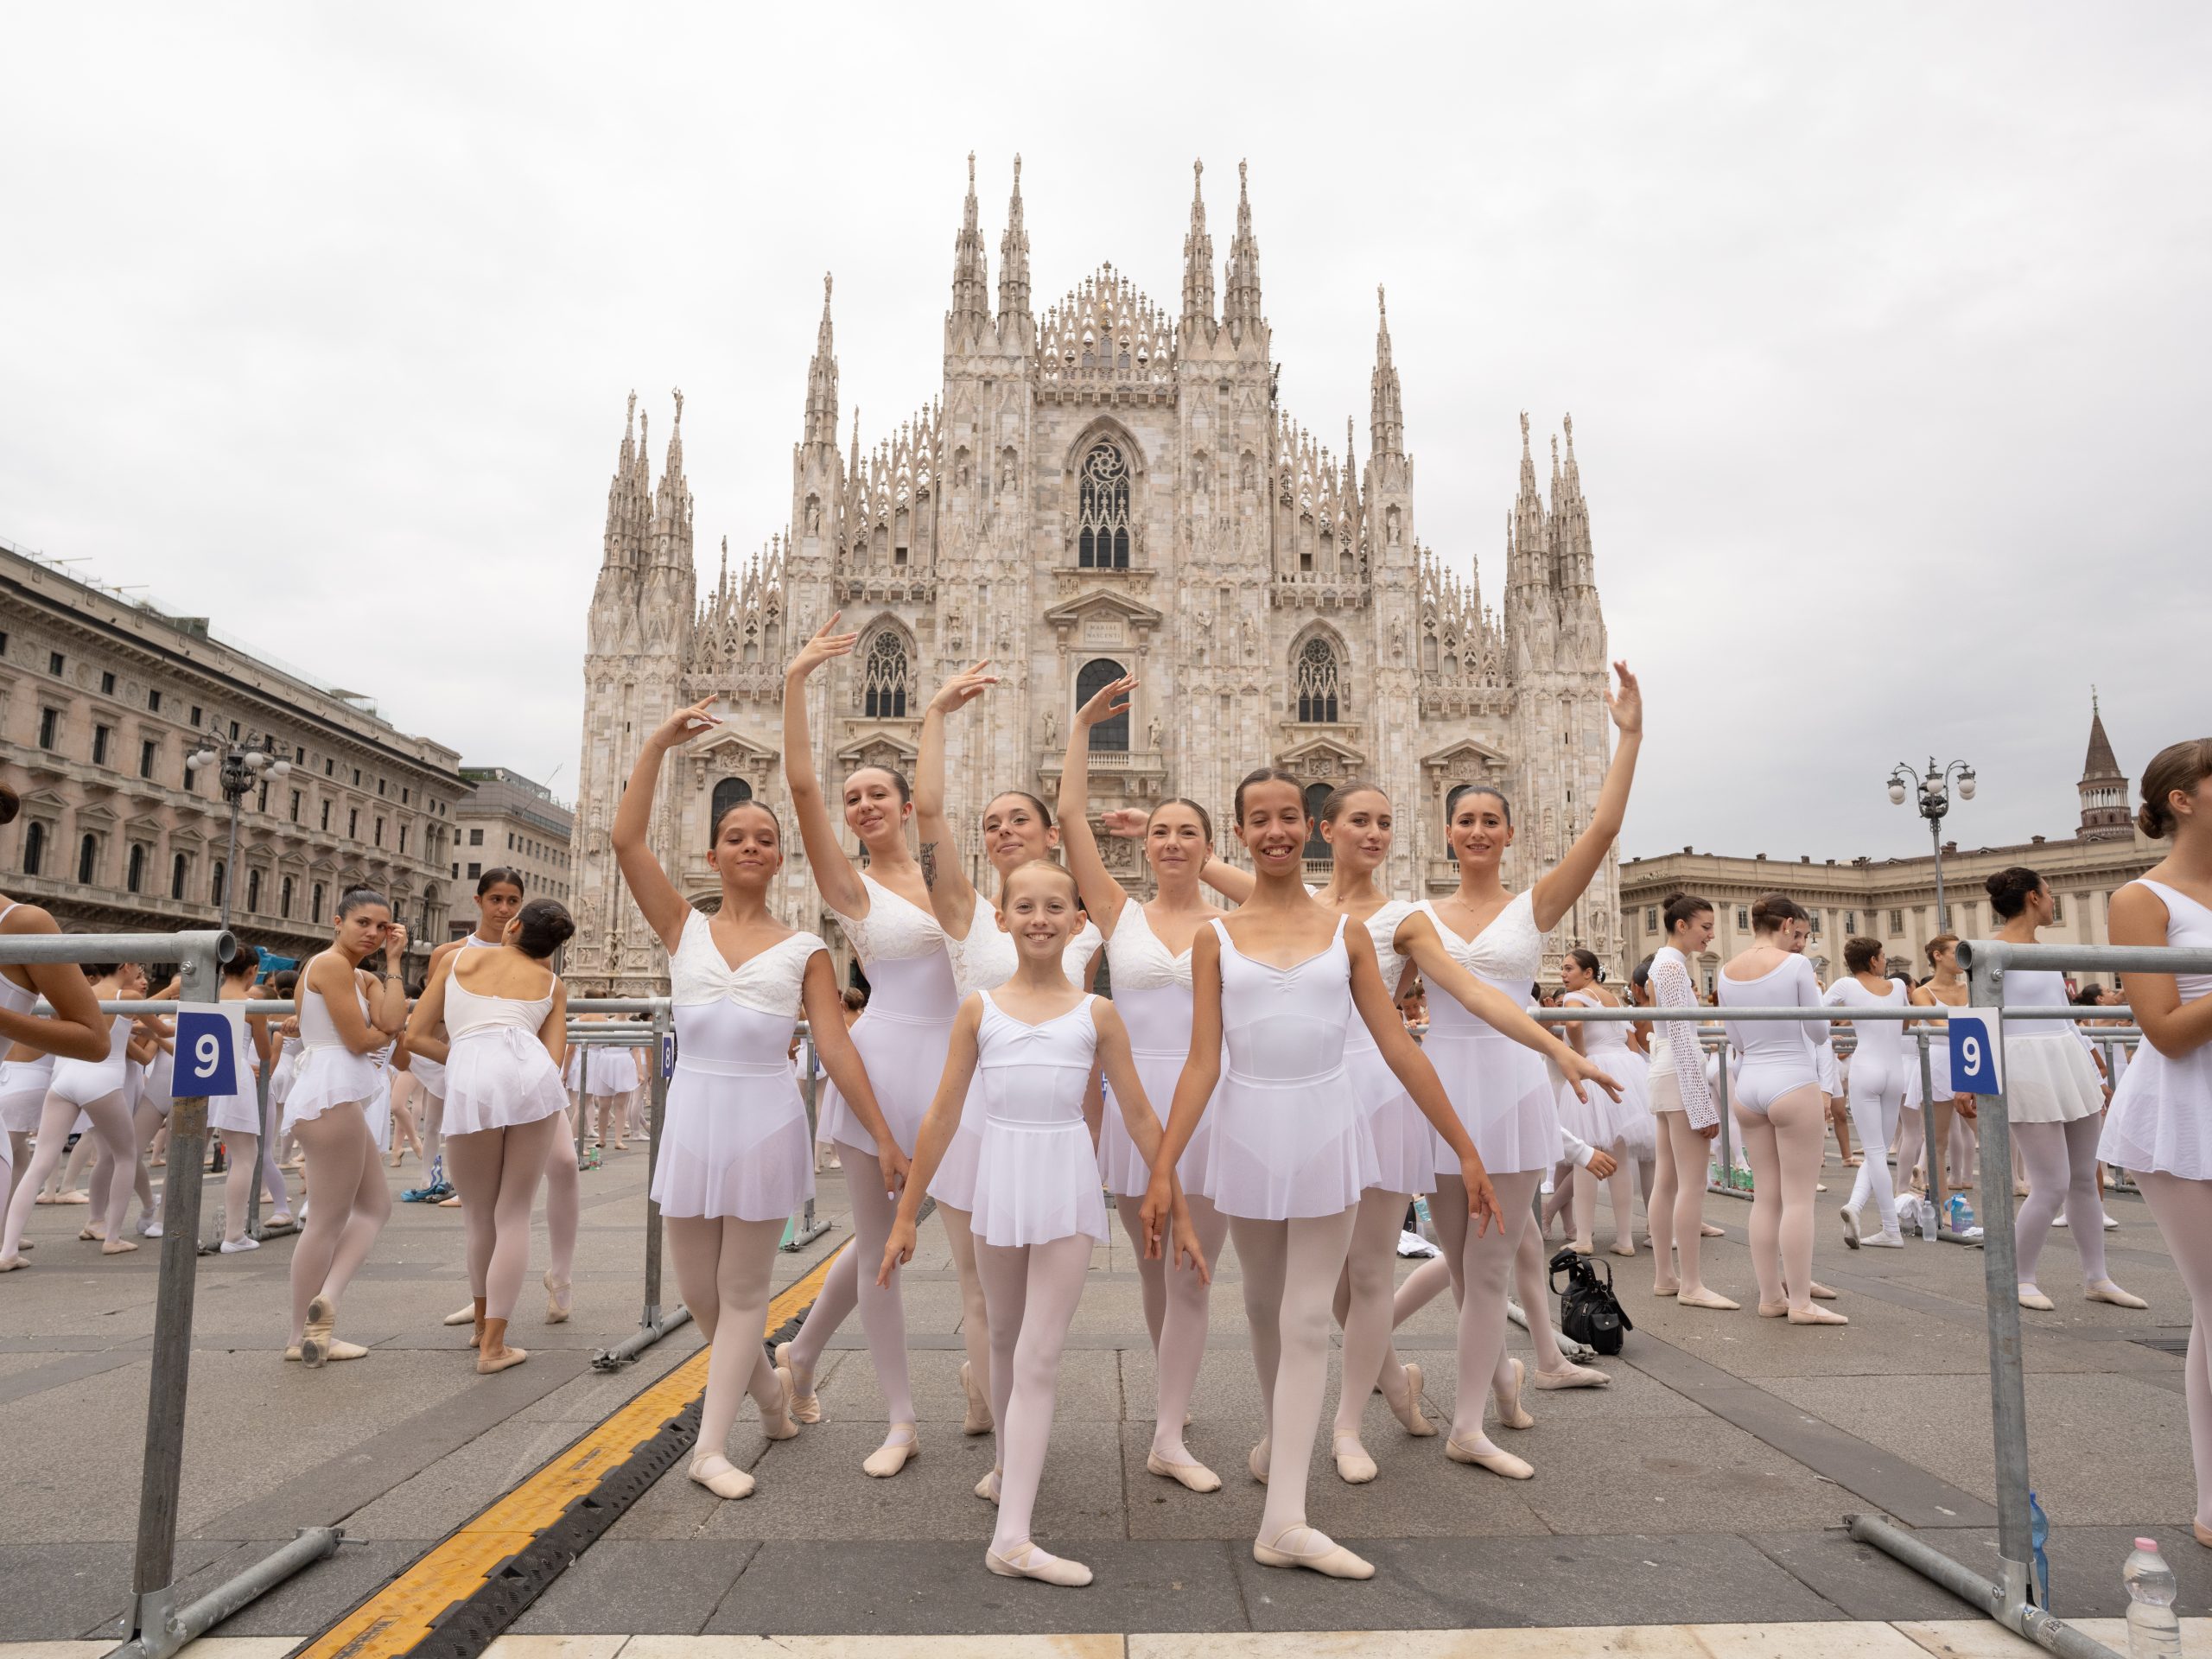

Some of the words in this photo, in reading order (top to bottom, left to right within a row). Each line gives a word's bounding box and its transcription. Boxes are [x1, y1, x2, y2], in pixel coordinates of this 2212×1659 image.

[194, 1033, 219, 1078] 9
[665, 1046, 671, 1069] 8
[1962, 1036, 1981, 1077] 9
